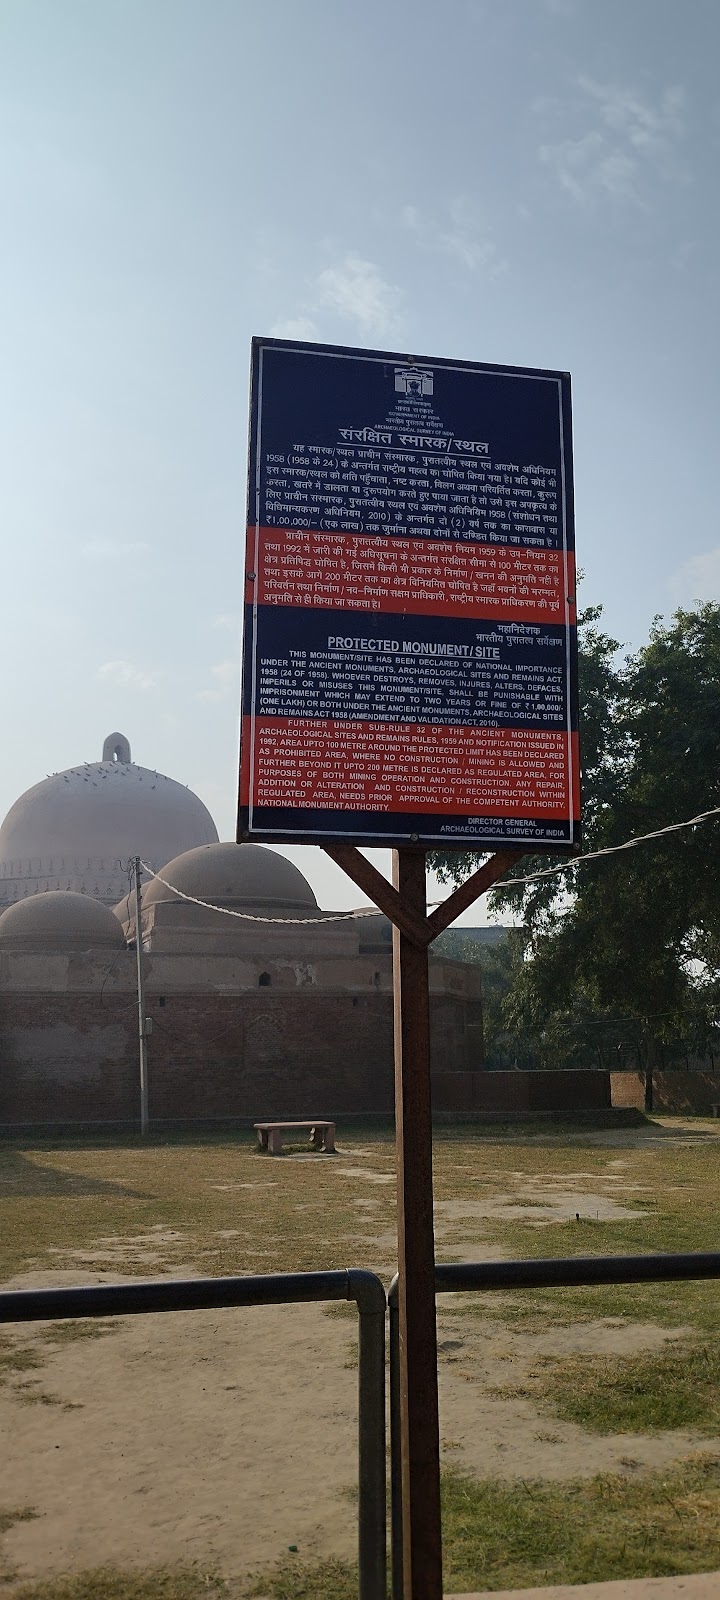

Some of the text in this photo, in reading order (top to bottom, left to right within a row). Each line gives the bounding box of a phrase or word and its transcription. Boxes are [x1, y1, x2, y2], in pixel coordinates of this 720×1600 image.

[338, 426, 392, 444] संरक्षित
[264, 543, 280, 551] तथा
[283, 544, 301, 553] 1992
[312, 545, 330, 555] जारी
[332, 546, 343, 556] की
[345, 547, 357, 558] गई
[360, 548, 398, 562] अधिसूचना
[399, 551, 408, 561] के
[410, 553, 438, 563] अन्तर्गत
[440, 555, 467, 566] संरक्षित
[468, 557, 487, 567] सीमा
[488, 558, 496, 568] से
[513, 560, 531, 571] मीटर
[533, 564, 546, 572] तक
[264, 592, 293, 604] अनुमति
[294, 593, 302, 603] से
[303, 594, 312, 604] ही
[313, 594, 333, 605] किया
[334, 598, 345, 606] जा
[346, 599, 370, 608] सकता
[476, 632, 503, 643] भारतीय
[506, 636, 534, 646] पुरातत्व
[497, 623, 540, 635] महानिदेशक
[328, 637, 399, 651] PROTECTED
[261, 658, 288, 666] UNDER
[309, 661, 342, 669] ANCIENT
[345, 664, 396, 674] MONUMENTS,
[398, 667, 468, 677] ARCHAEOLOGICAL
[470, 671, 491, 679] SITES
[512, 674, 544, 682] REMAINS
[547, 676, 562, 684] ACT,
[289, 650, 307, 658] THIS
[310, 652, 373, 662] MONUMENT/SITE
[419, 659, 459, 667] DECLARED
[476, 662, 512, 671] NATIONAL
[516, 665, 562, 674] IMPORTANCE
[260, 678, 297, 686] IMPERILS
[319, 681, 353, 690] MISUSES
[380, 685, 444, 696] MONUMENT/SITE,
[449, 689, 473, 697] SHALL
[494, 692, 540, 700] PUNISHABLE
[280, 669, 292, 677] (24
[308, 671, 329, 680] 1958).
[332, 672, 370, 681] WHOEVER
[373, 675, 416, 684] DESTROYS,
[419, 678, 457, 687] REMOVES,
[459, 680, 492, 689] INJURES,
[495, 682, 525, 691] ALTERS,
[528, 684, 563, 693] DEFACES,
[288, 719, 327, 728] FURTHER
[334, 722, 362, 730] UNDER
[369, 724, 410, 732] SUB-RULE
[511, 732, 564, 741] MONUMENTS,
[259, 758, 296, 767] FURTHER
[299, 760, 331, 768] BEYOND
[383, 764, 408, 772] METRE
[421, 766, 462, 774] DECLARED
[477, 769, 522, 777] REGULATED
[524, 771, 546, 779] AREA,
[259, 769, 302, 777] PURPOSES
[382, 774, 425, 782] OPERATION
[451, 778, 511, 786] CONSTRUCTION.
[536, 781, 565, 790] REPAIR,
[258, 789, 306, 797] REGULATED
[312, 791, 336, 800] AREA,
[340, 792, 366, 800] NEEDS
[399, 795, 440, 803] APPROVAL
[473, 798, 519, 806] COMPETENT
[522, 800, 565, 809] AUTHORITY,
[258, 799, 389, 811] NATIONAL MONUMENT AUTHORITY.
[440, 825, 505, 834] ARCHAEOLOGICAL
[505, 819, 537, 827] GENERAL
